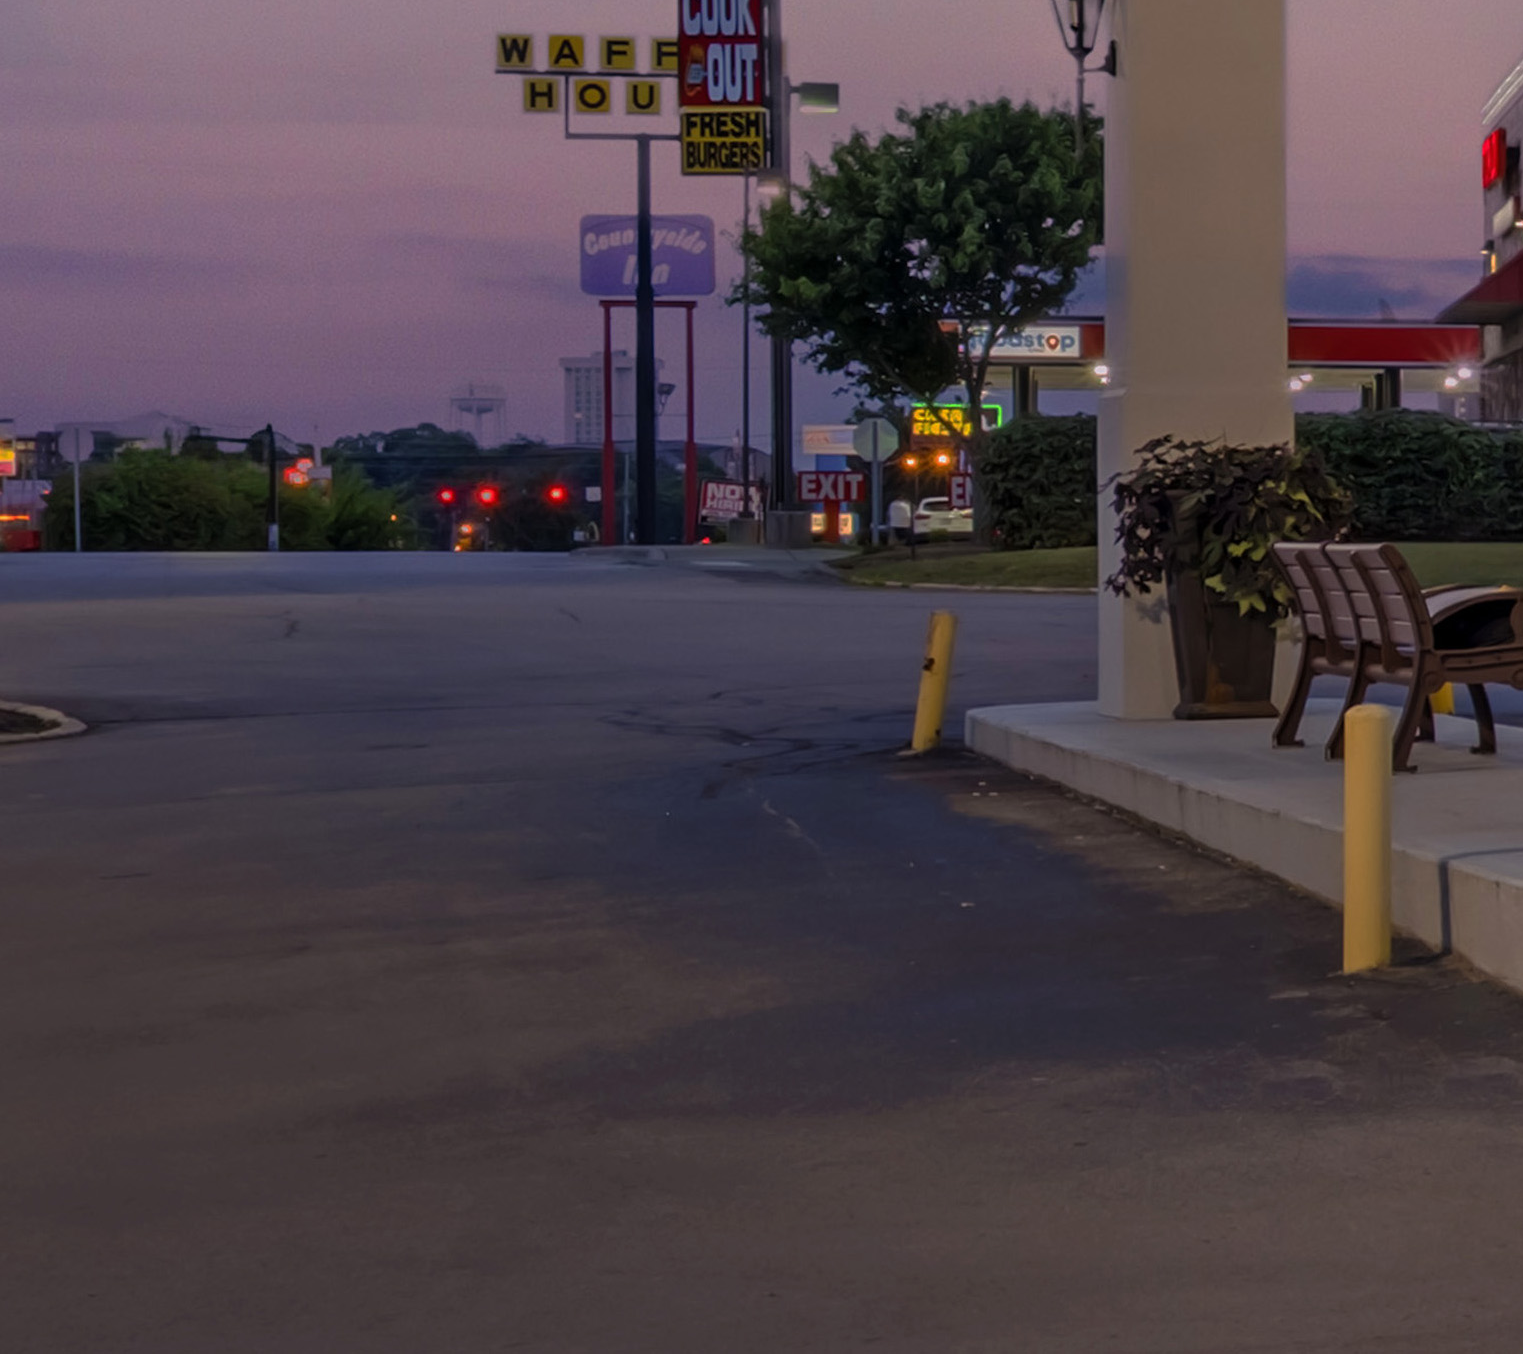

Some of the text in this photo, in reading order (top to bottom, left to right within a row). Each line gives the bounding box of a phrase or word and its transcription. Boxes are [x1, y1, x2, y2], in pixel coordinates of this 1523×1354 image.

[707, 43, 758, 102] OUT
[685, 112, 759, 138] FRESH
[686, 142, 761, 169] BURGERS
[584, 227, 708, 255] Counyside
[622, 254, 671, 285] In
[801, 474, 863, 500] EXIT
